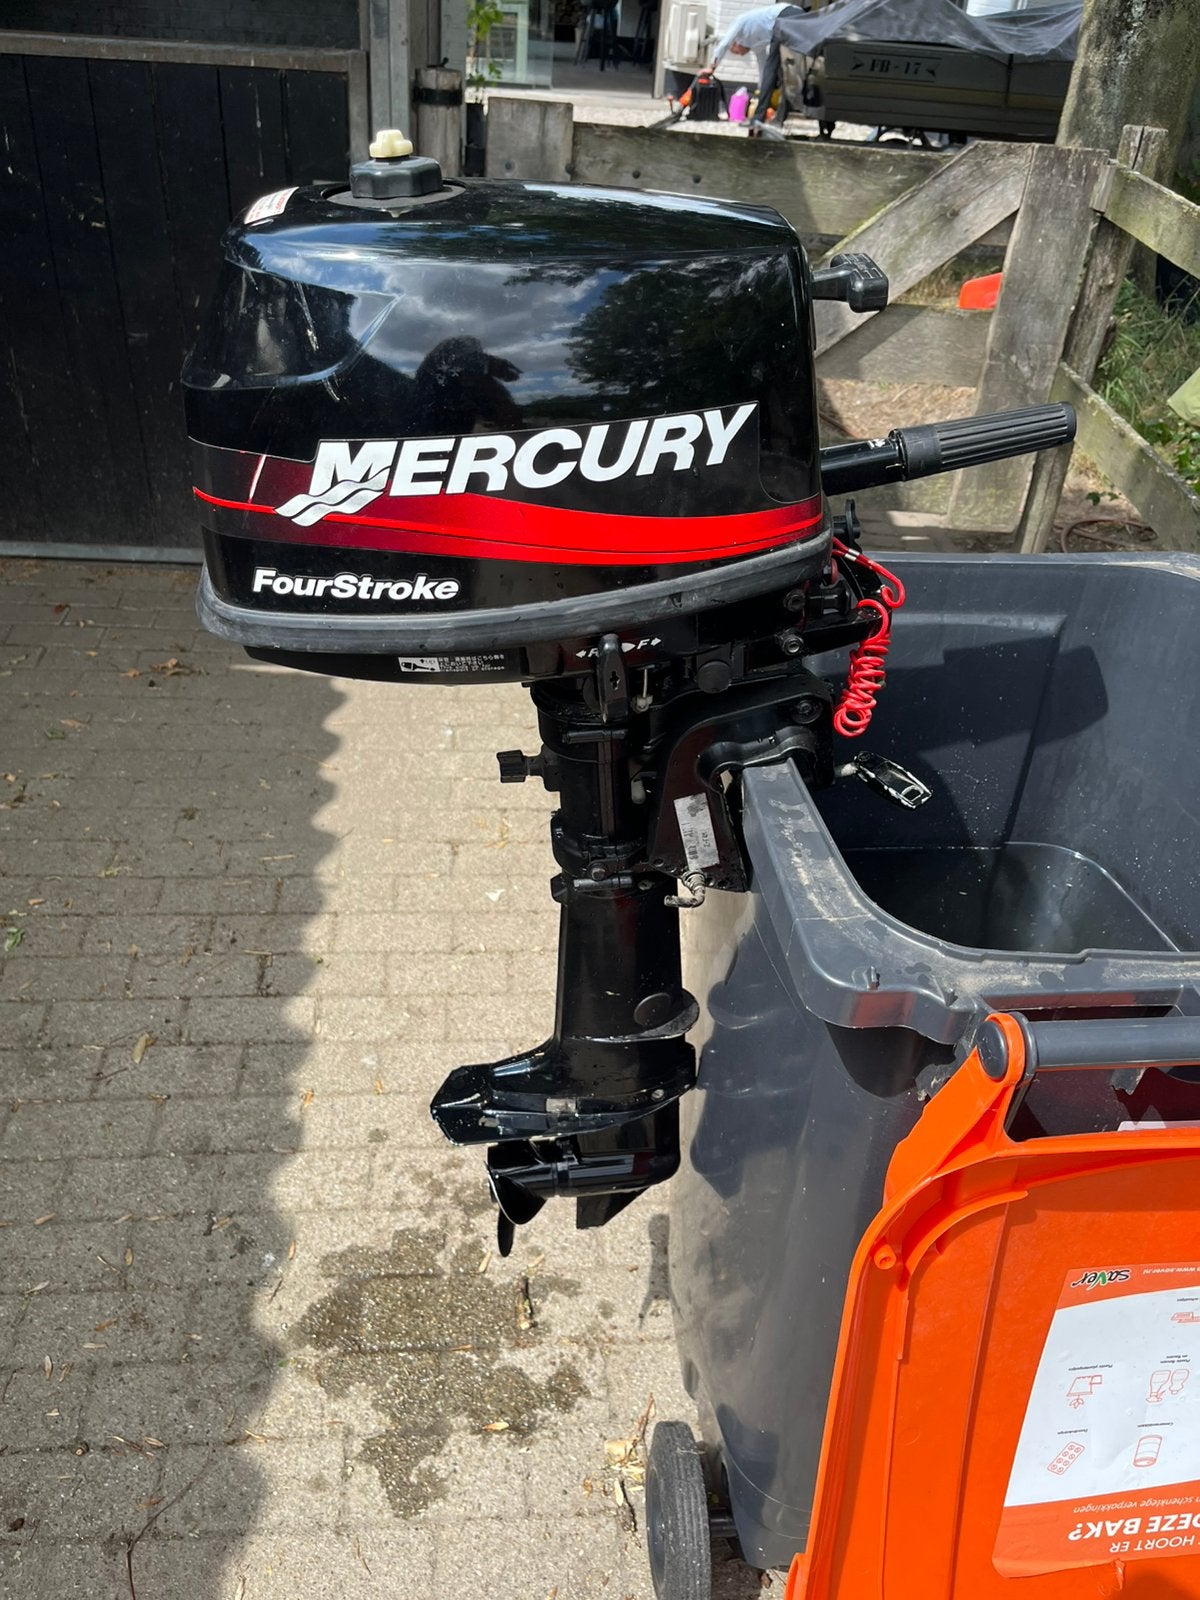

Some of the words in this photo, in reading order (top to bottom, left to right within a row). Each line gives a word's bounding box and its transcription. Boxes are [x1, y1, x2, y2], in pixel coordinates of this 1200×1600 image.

[275, 402, 759, 527] MERCURY
[252, 568, 460, 600] FourStroke
[1073, 1500, 1138, 1514] verpakkingen
[1068, 1517, 1142, 1541] BAK?
[1109, 1540, 1131, 1553] ER
[1133, 1535, 1196, 1551] HOORT
